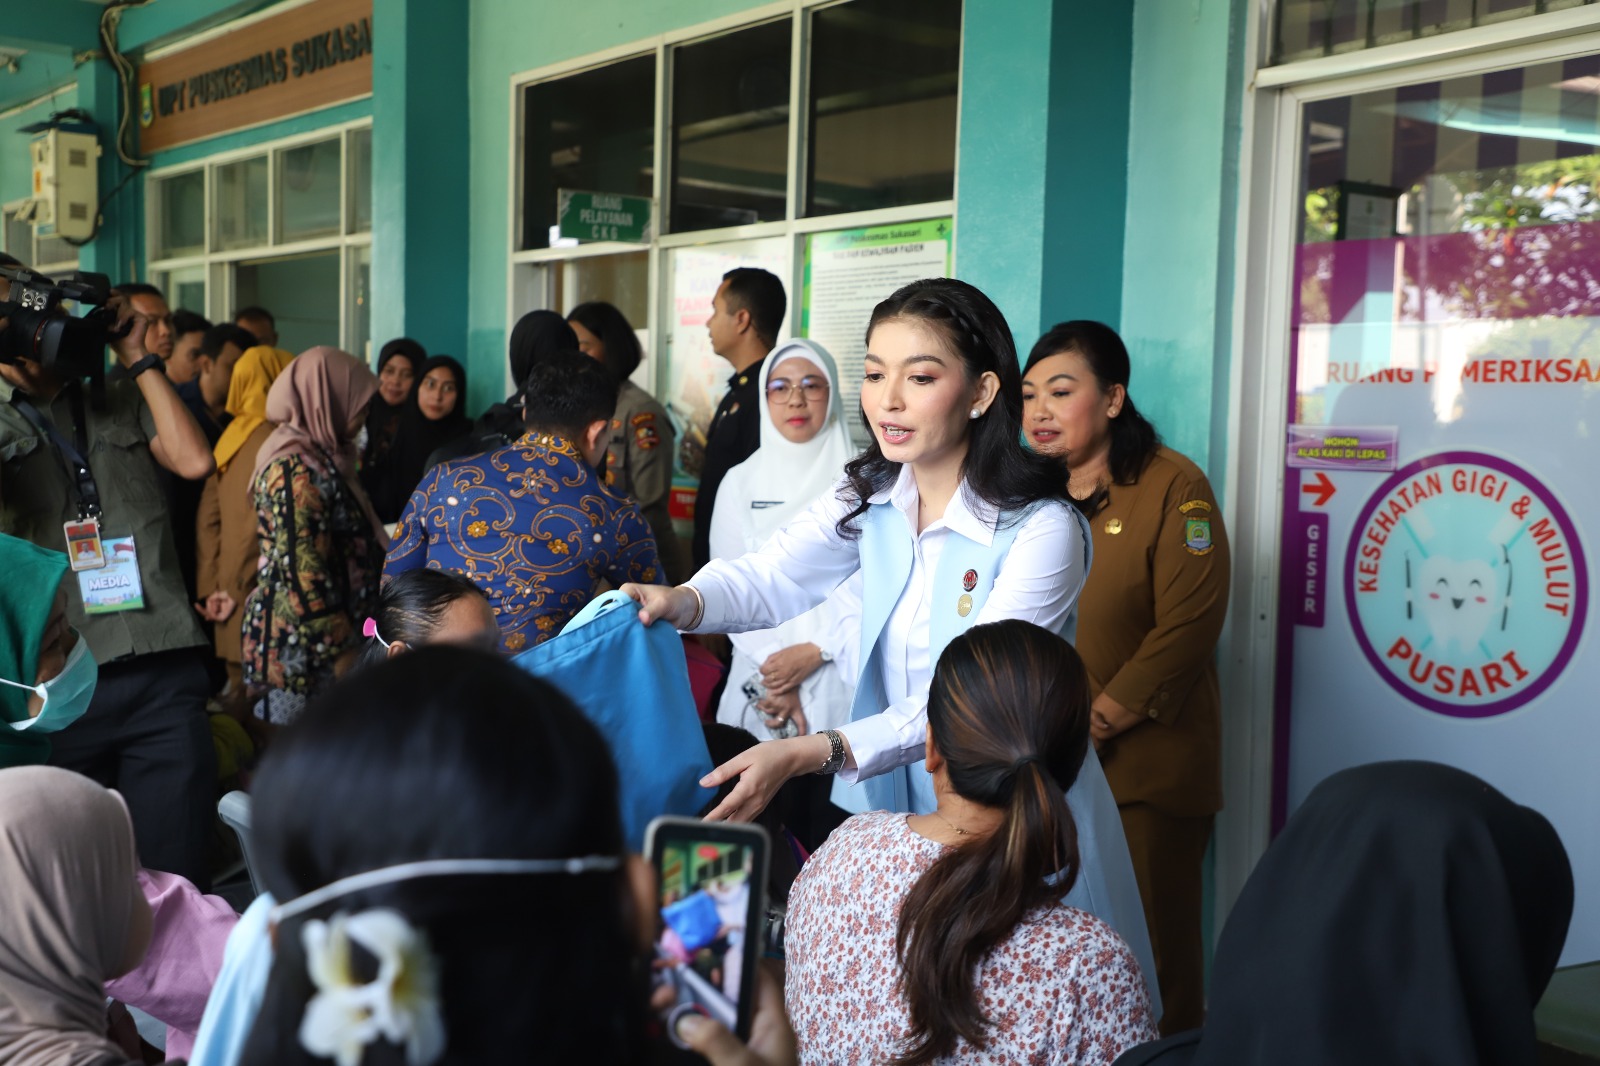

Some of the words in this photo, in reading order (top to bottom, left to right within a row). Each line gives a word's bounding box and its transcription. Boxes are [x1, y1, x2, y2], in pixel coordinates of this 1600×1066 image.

[188, 47, 288, 109] PUSKESMAS
[291, 15, 373, 78] SUKASA
[591, 195, 622, 210] RUANG
[580, 209, 633, 226] PELAYANAN
[1424, 358, 1600, 383] PMERIKSA
[1324, 437, 1359, 447] MOHON
[1297, 447, 1320, 457] ALAS
[1322, 448, 1343, 458] KAKI
[1345, 448, 1355, 458] DI
[1357, 449, 1387, 460] LEPAS
[1359, 472, 1443, 592] KESEHATAN
[1452, 469, 1508, 502] GIGI
[1510, 495, 1532, 520] &
[1528, 518, 1570, 617] MULUT
[1304, 524, 1320, 613] GESER
[88, 574, 130, 591] MEDIA
[1386, 636, 1529, 697] PUSARI
